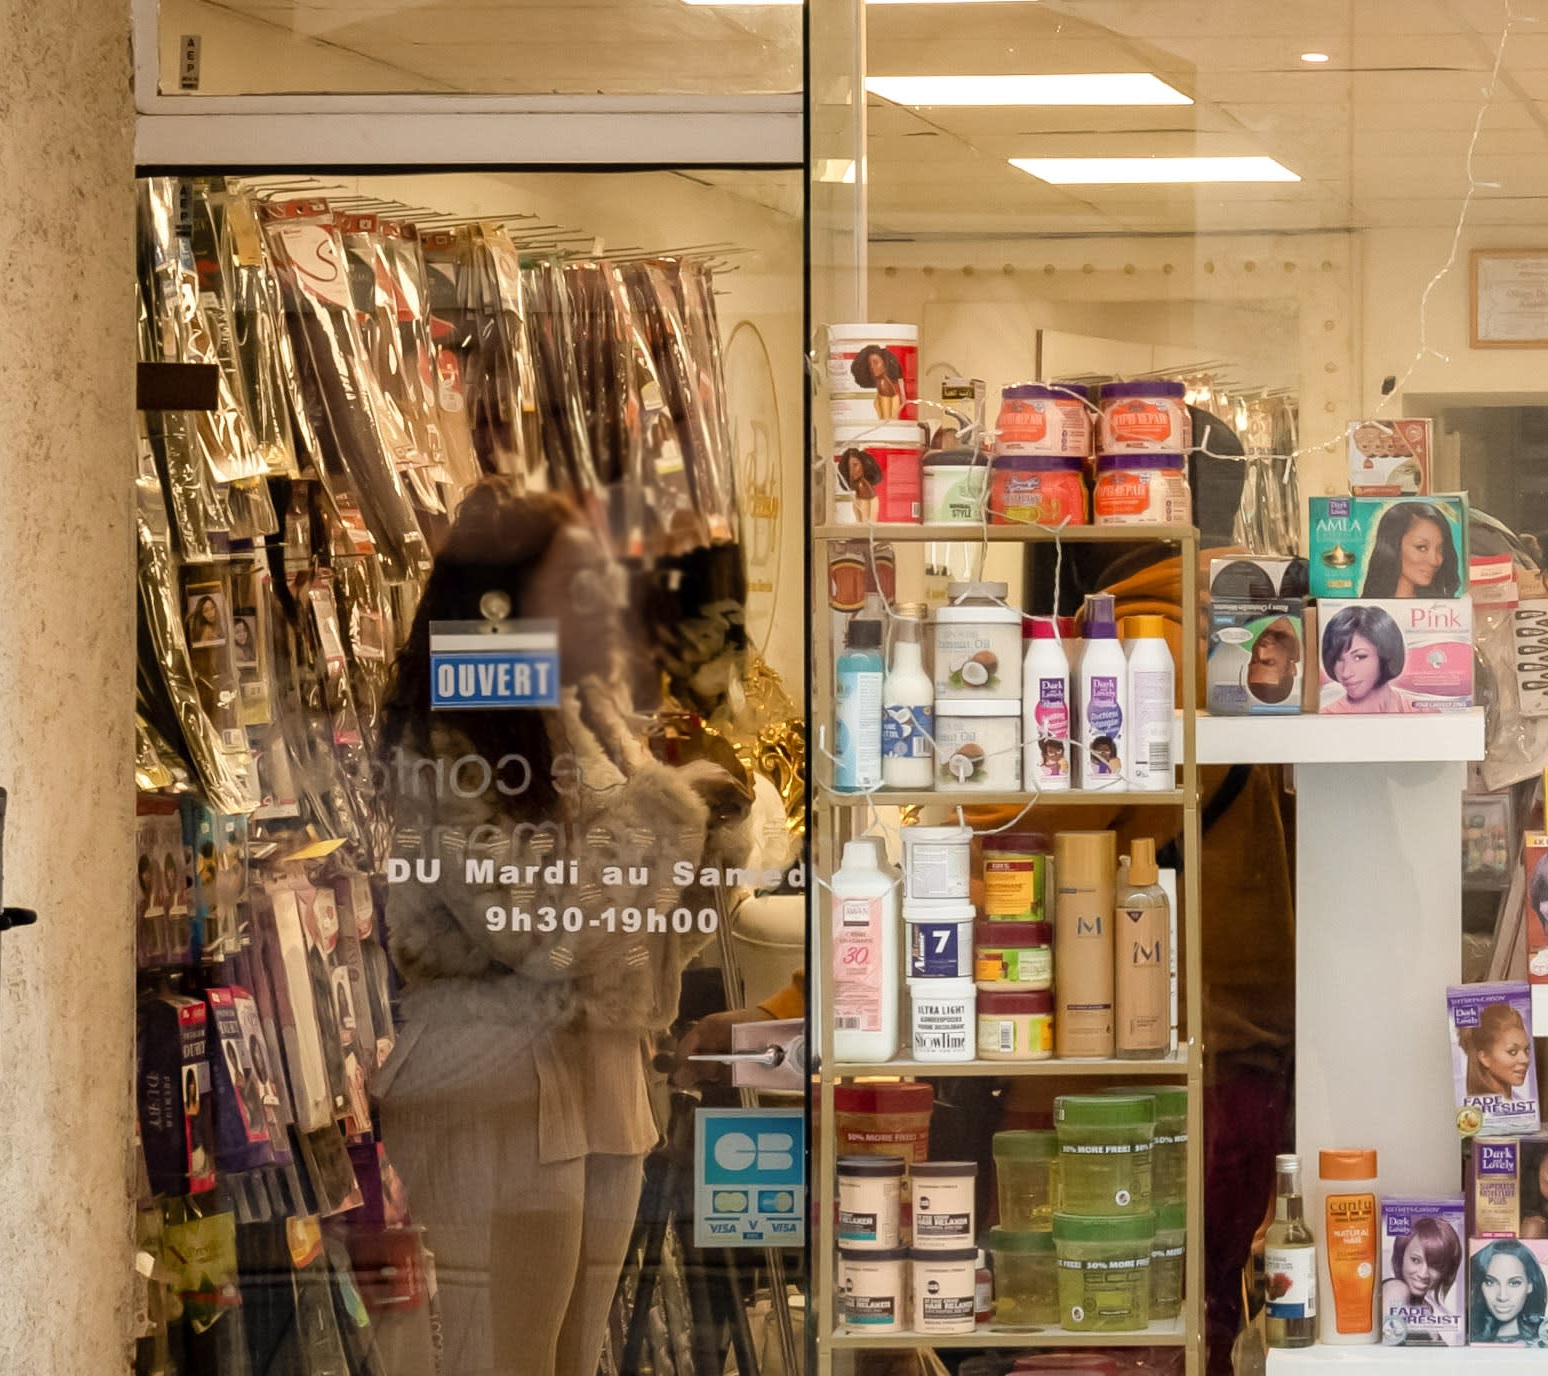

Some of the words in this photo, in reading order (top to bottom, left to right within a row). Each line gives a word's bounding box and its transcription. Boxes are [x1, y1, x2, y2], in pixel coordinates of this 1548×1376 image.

[1410, 607, 1462, 627] Pink
[437, 661, 551, 698] OUVERT
[387, 858, 441, 884] DU
[465, 858, 579, 885] Mardi
[602, 865, 649, 887] au
[485, 905, 719, 933] 9h30-19h00
[932, 929, 950, 954] 7
[1483, 1147, 1513, 1159] Dark
[710, 1224, 737, 1233] VISA
[772, 1224, 796, 1232] VISA
